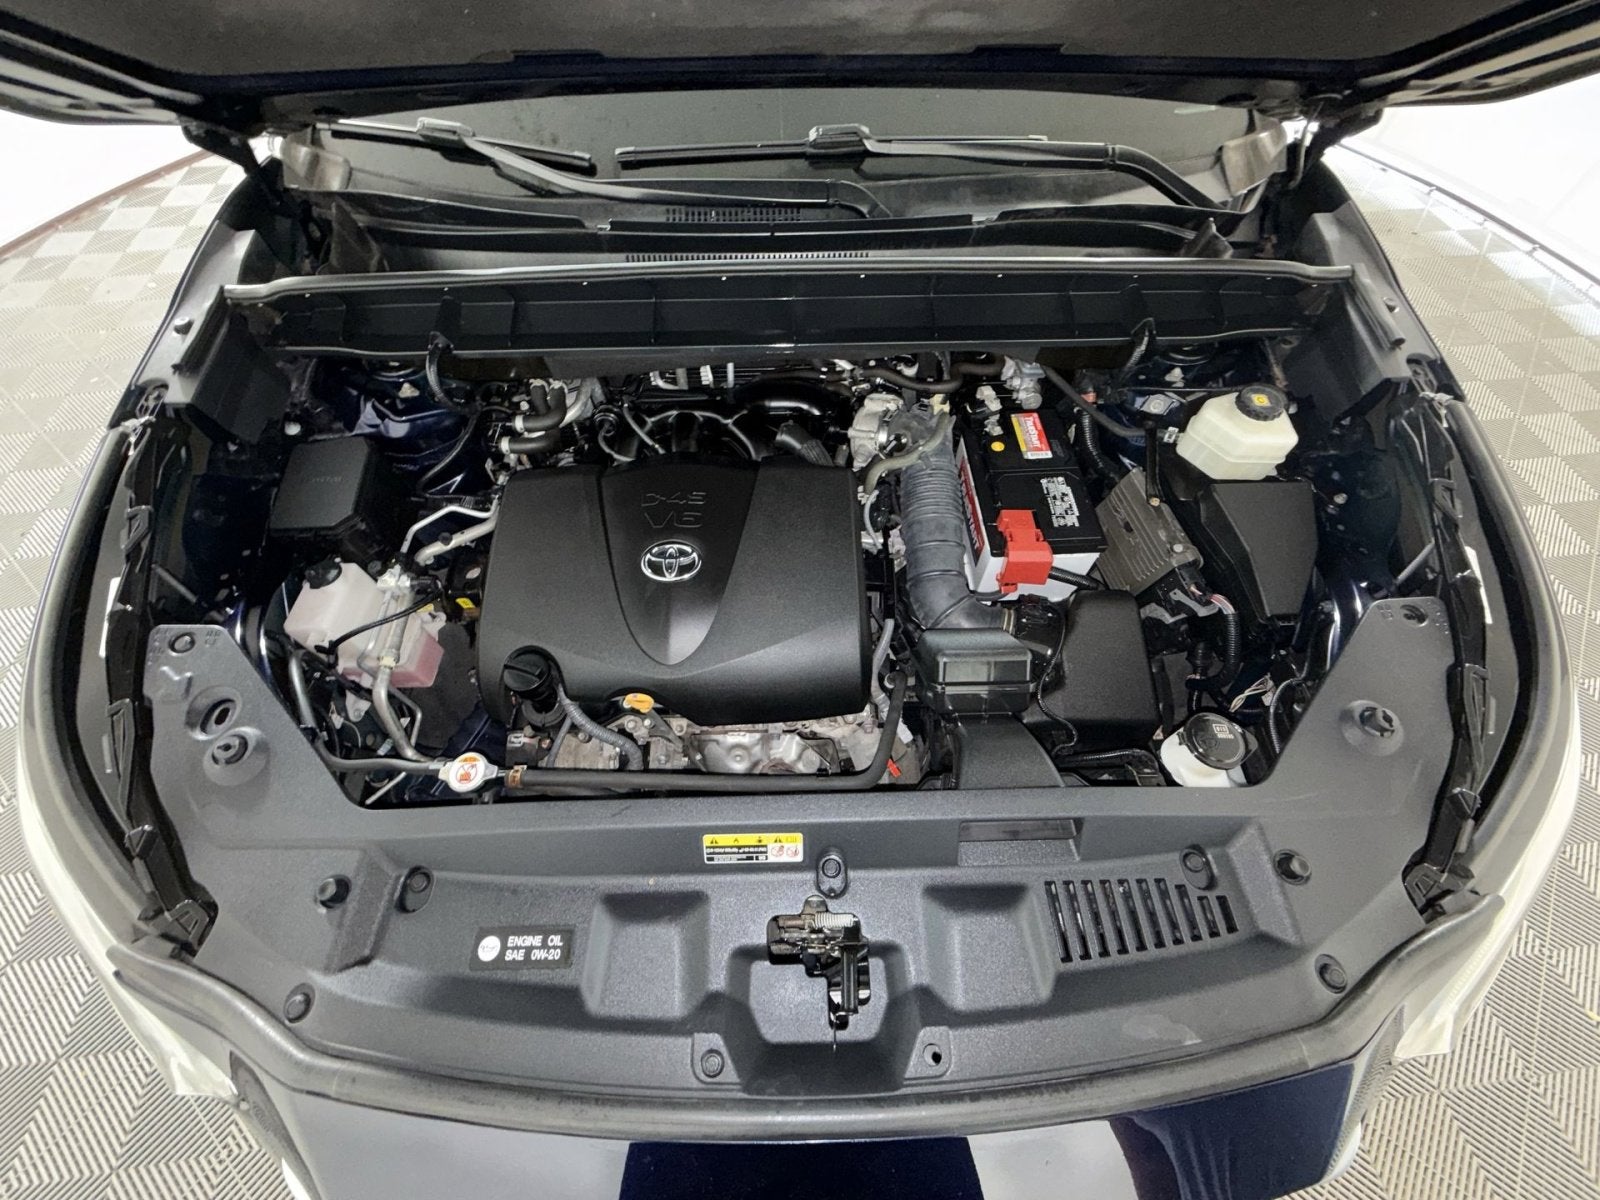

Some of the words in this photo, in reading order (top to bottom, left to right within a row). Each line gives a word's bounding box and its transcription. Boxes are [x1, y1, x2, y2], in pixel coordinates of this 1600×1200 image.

[643, 510, 704, 529] V6
[507, 935, 543, 947] ENGINE
[547, 935, 564, 947] OIL
[504, 949, 525, 961] SAE
[530, 949, 561, 960] 0W-20
